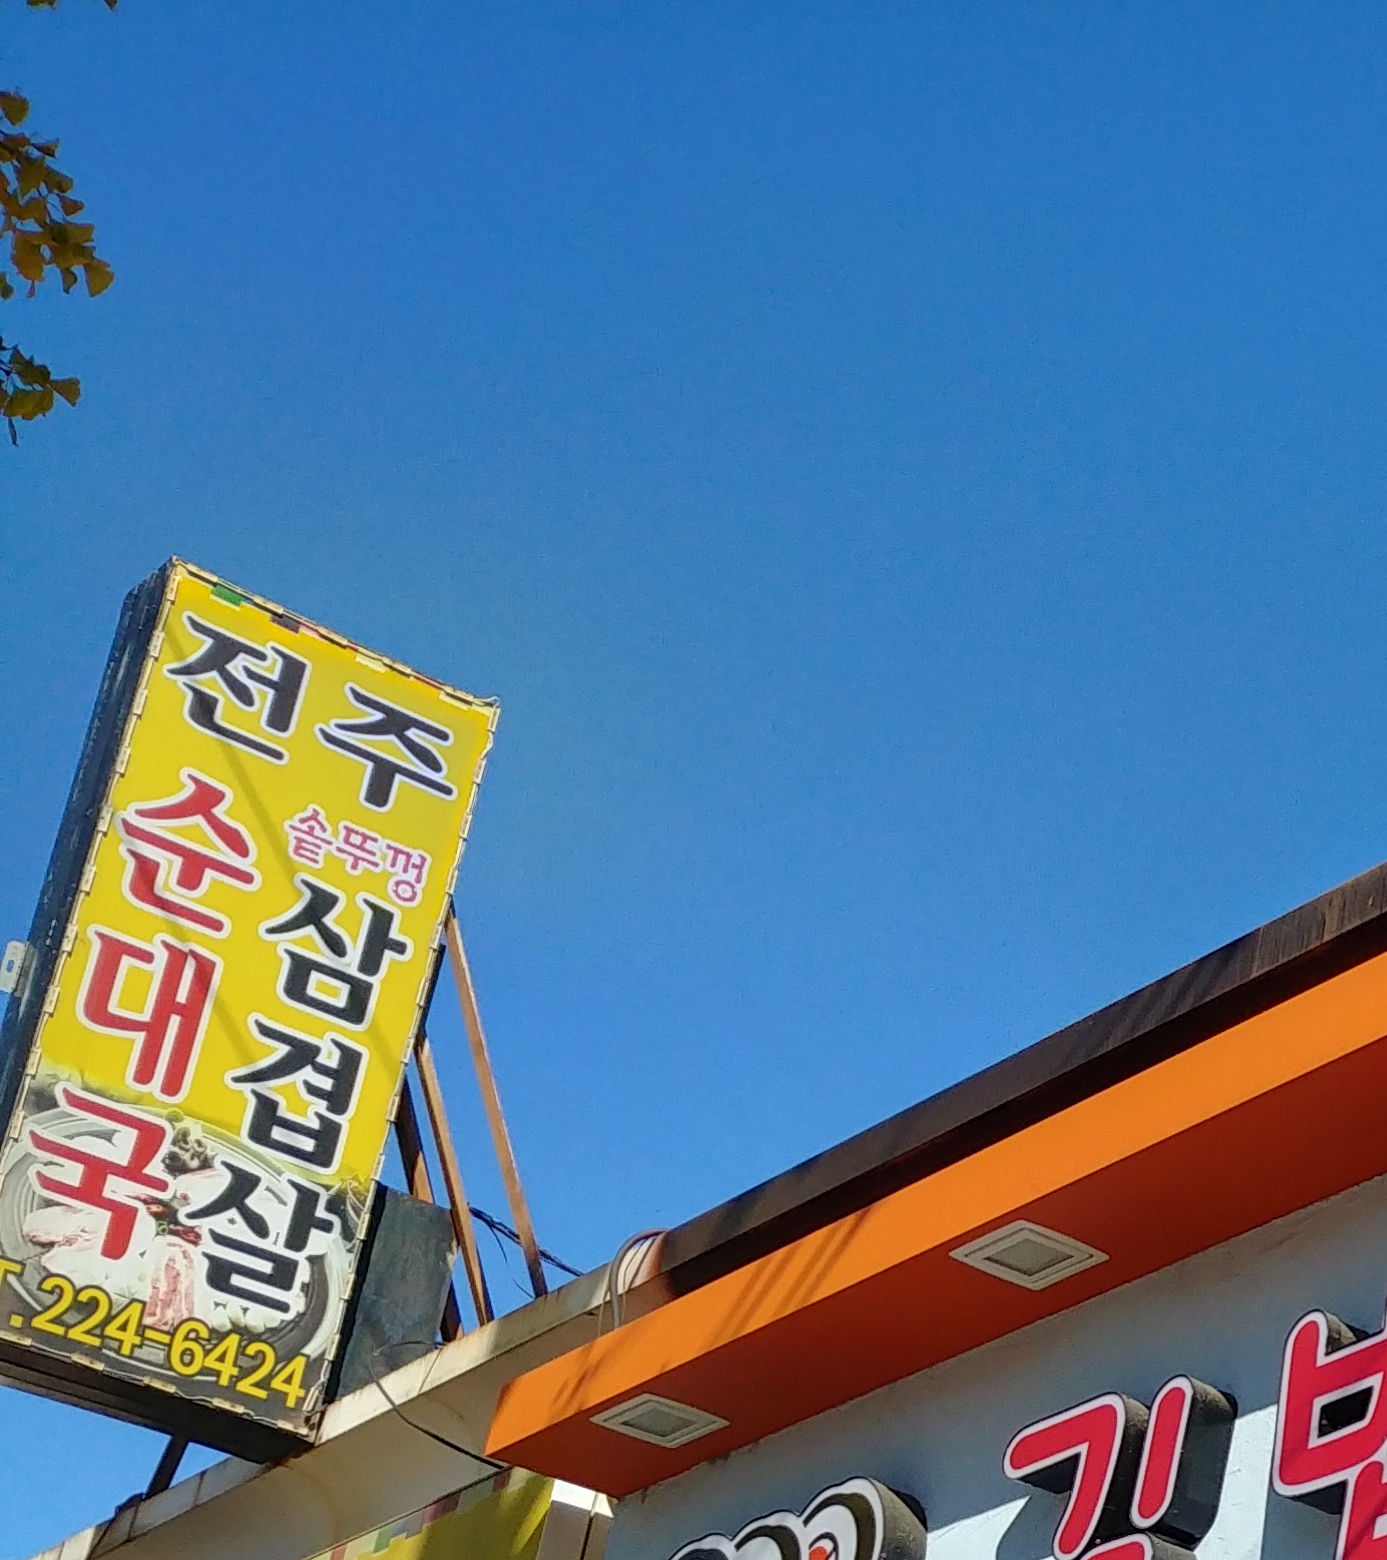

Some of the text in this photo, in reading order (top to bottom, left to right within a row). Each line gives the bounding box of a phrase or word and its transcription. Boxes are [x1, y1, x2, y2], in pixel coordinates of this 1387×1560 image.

[27, 767, 260, 1263] 순대국
[286, 806, 429, 904] 솥뚜껑
[182, 872, 413, 1319] 삼겹살
